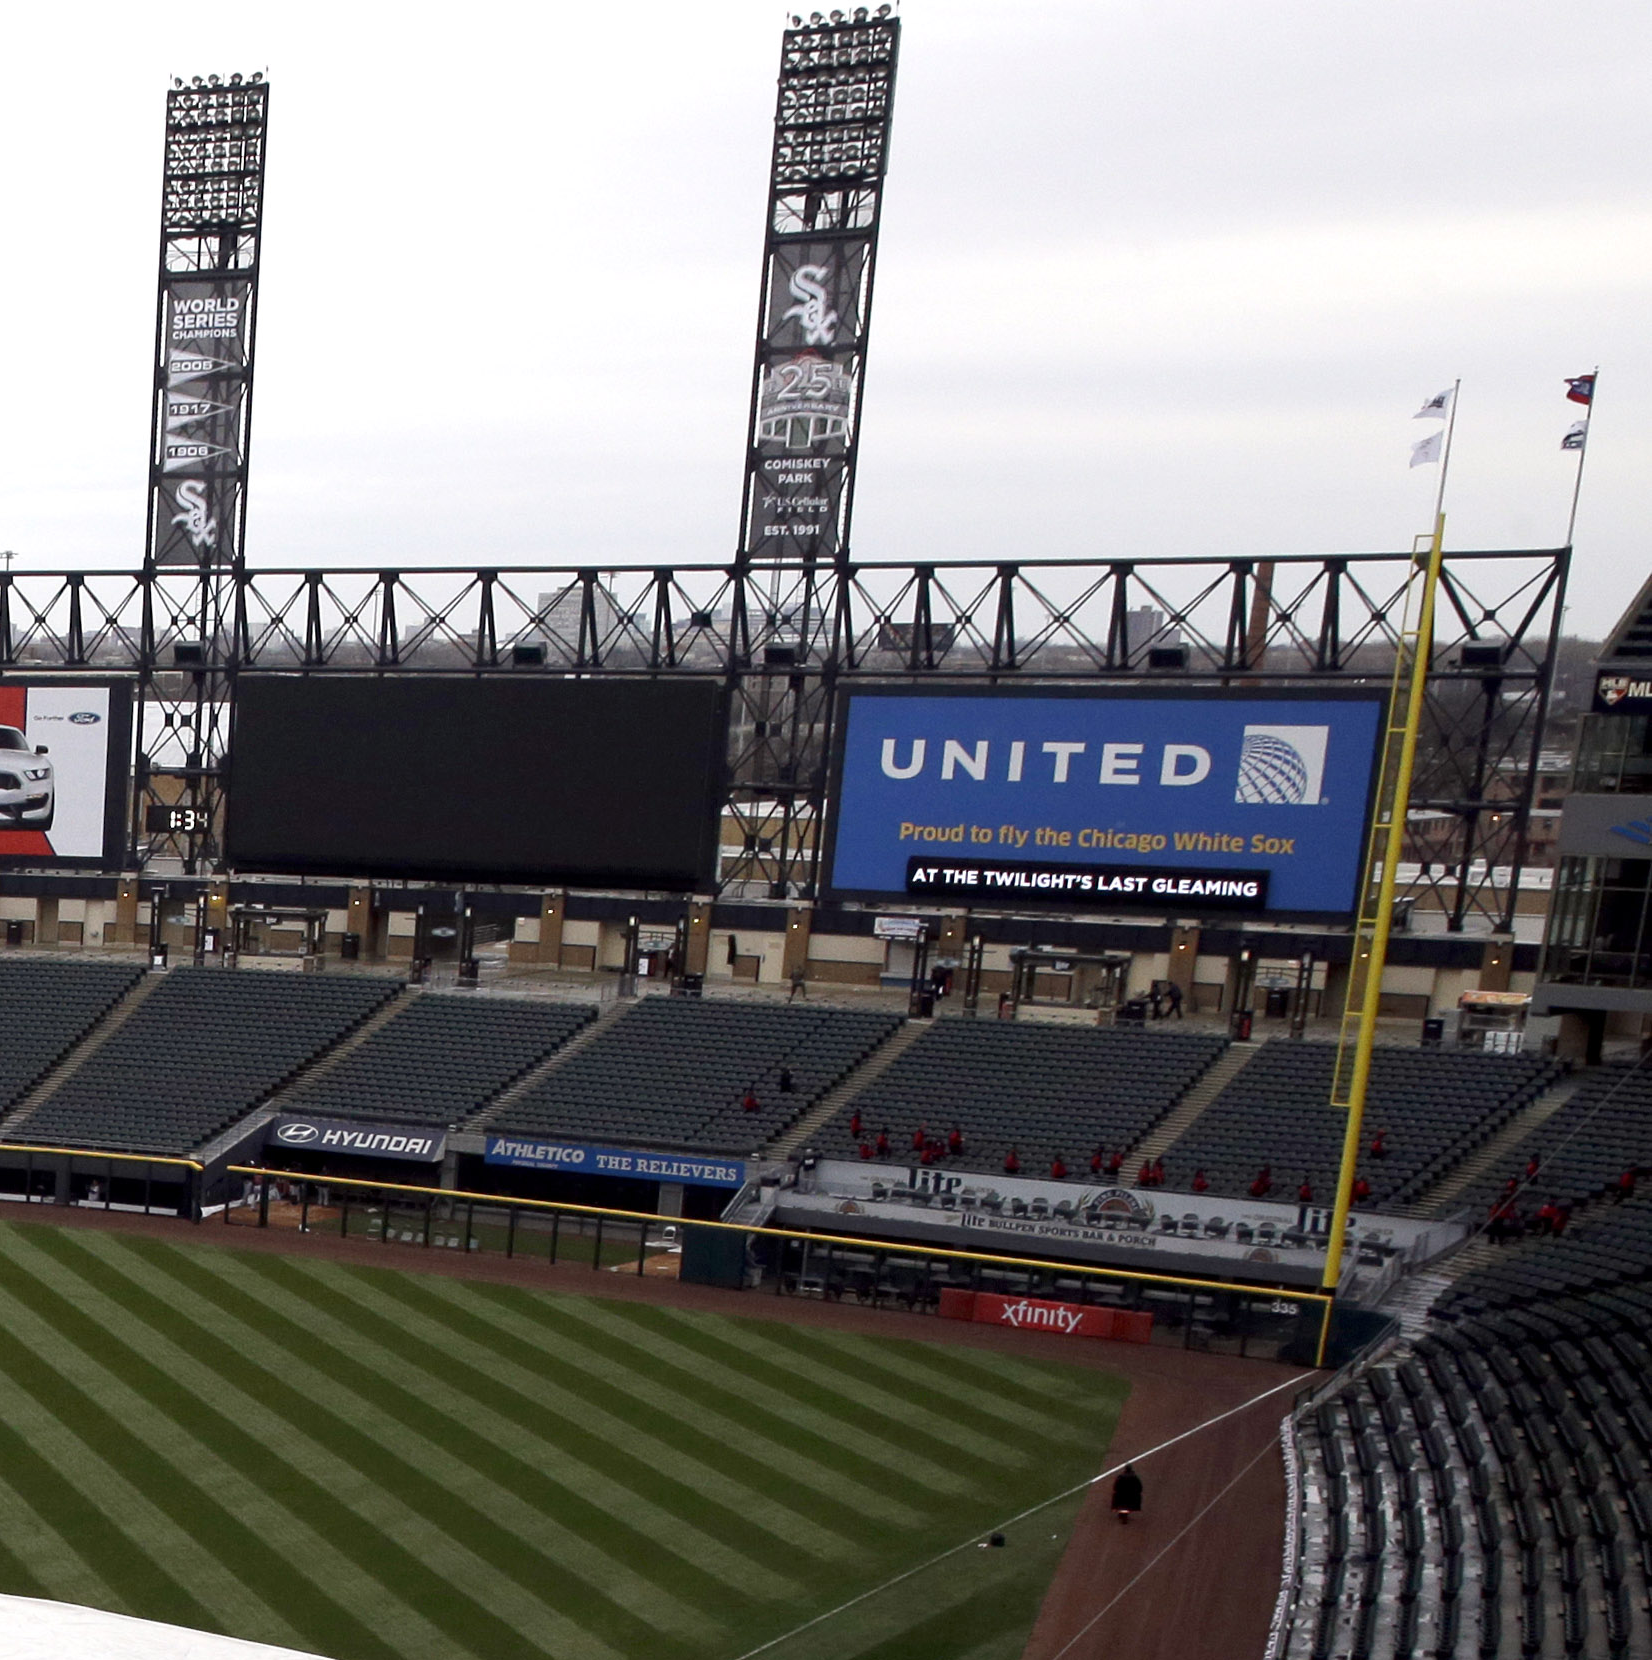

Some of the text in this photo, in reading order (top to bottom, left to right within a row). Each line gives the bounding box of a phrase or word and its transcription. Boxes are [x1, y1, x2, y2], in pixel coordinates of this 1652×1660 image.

[173, 298, 239, 314] WORLD
[173, 313, 238, 330] SERIES
[173, 328, 237, 339] CHAMPIONS
[777, 364, 833, 400] 25
[170, 404, 211, 414] 1917
[767, 401, 840, 415] ANNIVERSARY
[764, 458, 831, 470] COMISKEY
[778, 473, 813, 484] PARK
[764, 525, 820, 536] EST. 1991
[880, 738, 1212, 786] UNITED
[170, 810, 208, 830] 1:34
[900, 822, 1295, 855] Proud to fly the Chicago White Sox
[912, 868, 1258, 898] AT THE TWILIGHT'S LAST GLEAMING
[322, 1129, 433, 1154] HYUNDAI
[491, 1138, 585, 1164] ATHLETICO
[597, 1154, 737, 1182] THE RELIEVERS
[989, 1219, 1156, 1247] BULLPEN SPORTS BAR & PORCH
[1001, 1301, 1083, 1332] xfinity
[1271, 1301, 1297, 1315] 335
